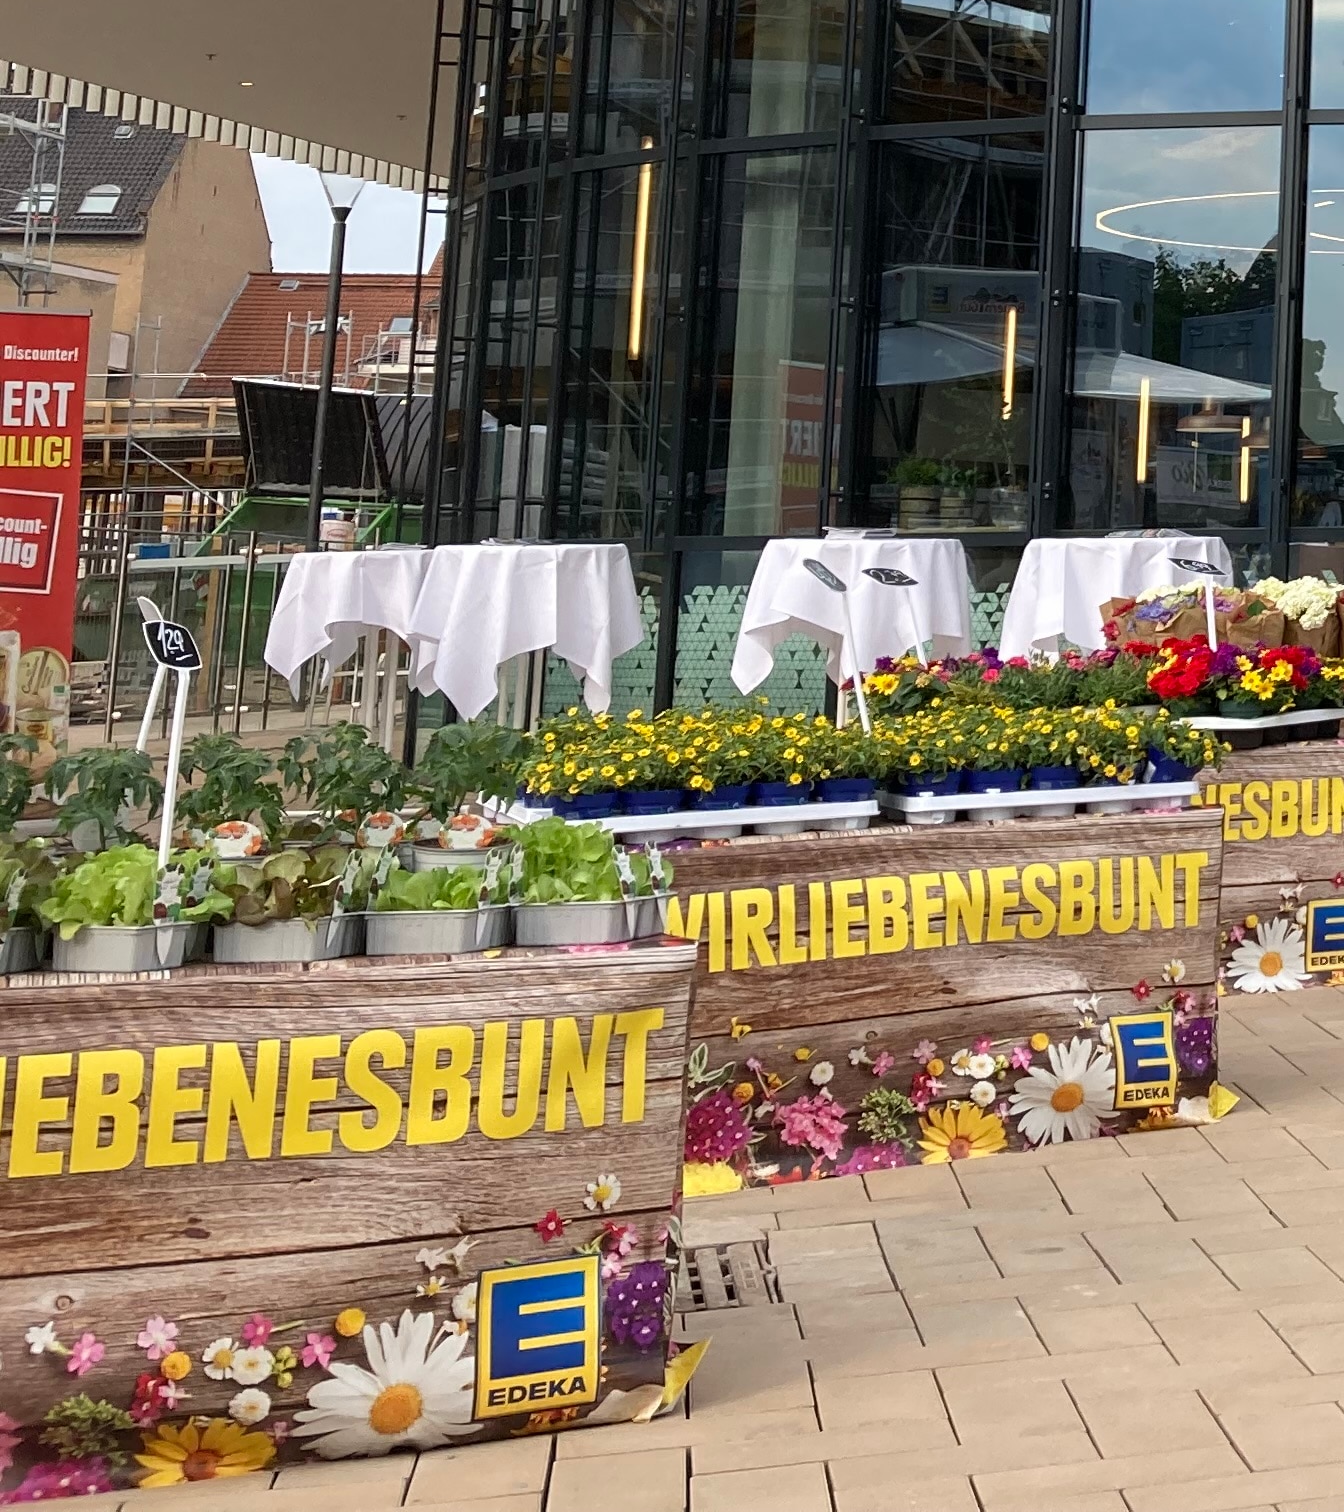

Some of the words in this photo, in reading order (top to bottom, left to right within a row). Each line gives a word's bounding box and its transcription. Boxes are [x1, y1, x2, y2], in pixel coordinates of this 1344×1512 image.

[3, 345, 79, 363] Discounter!
[2, 380, 76, 428] ERT
[0, 1009, 664, 1179] EBENESBUNT
[1123, 1086, 1171, 1102] EDEKA
[487, 1376, 587, 1408] EDEKA
